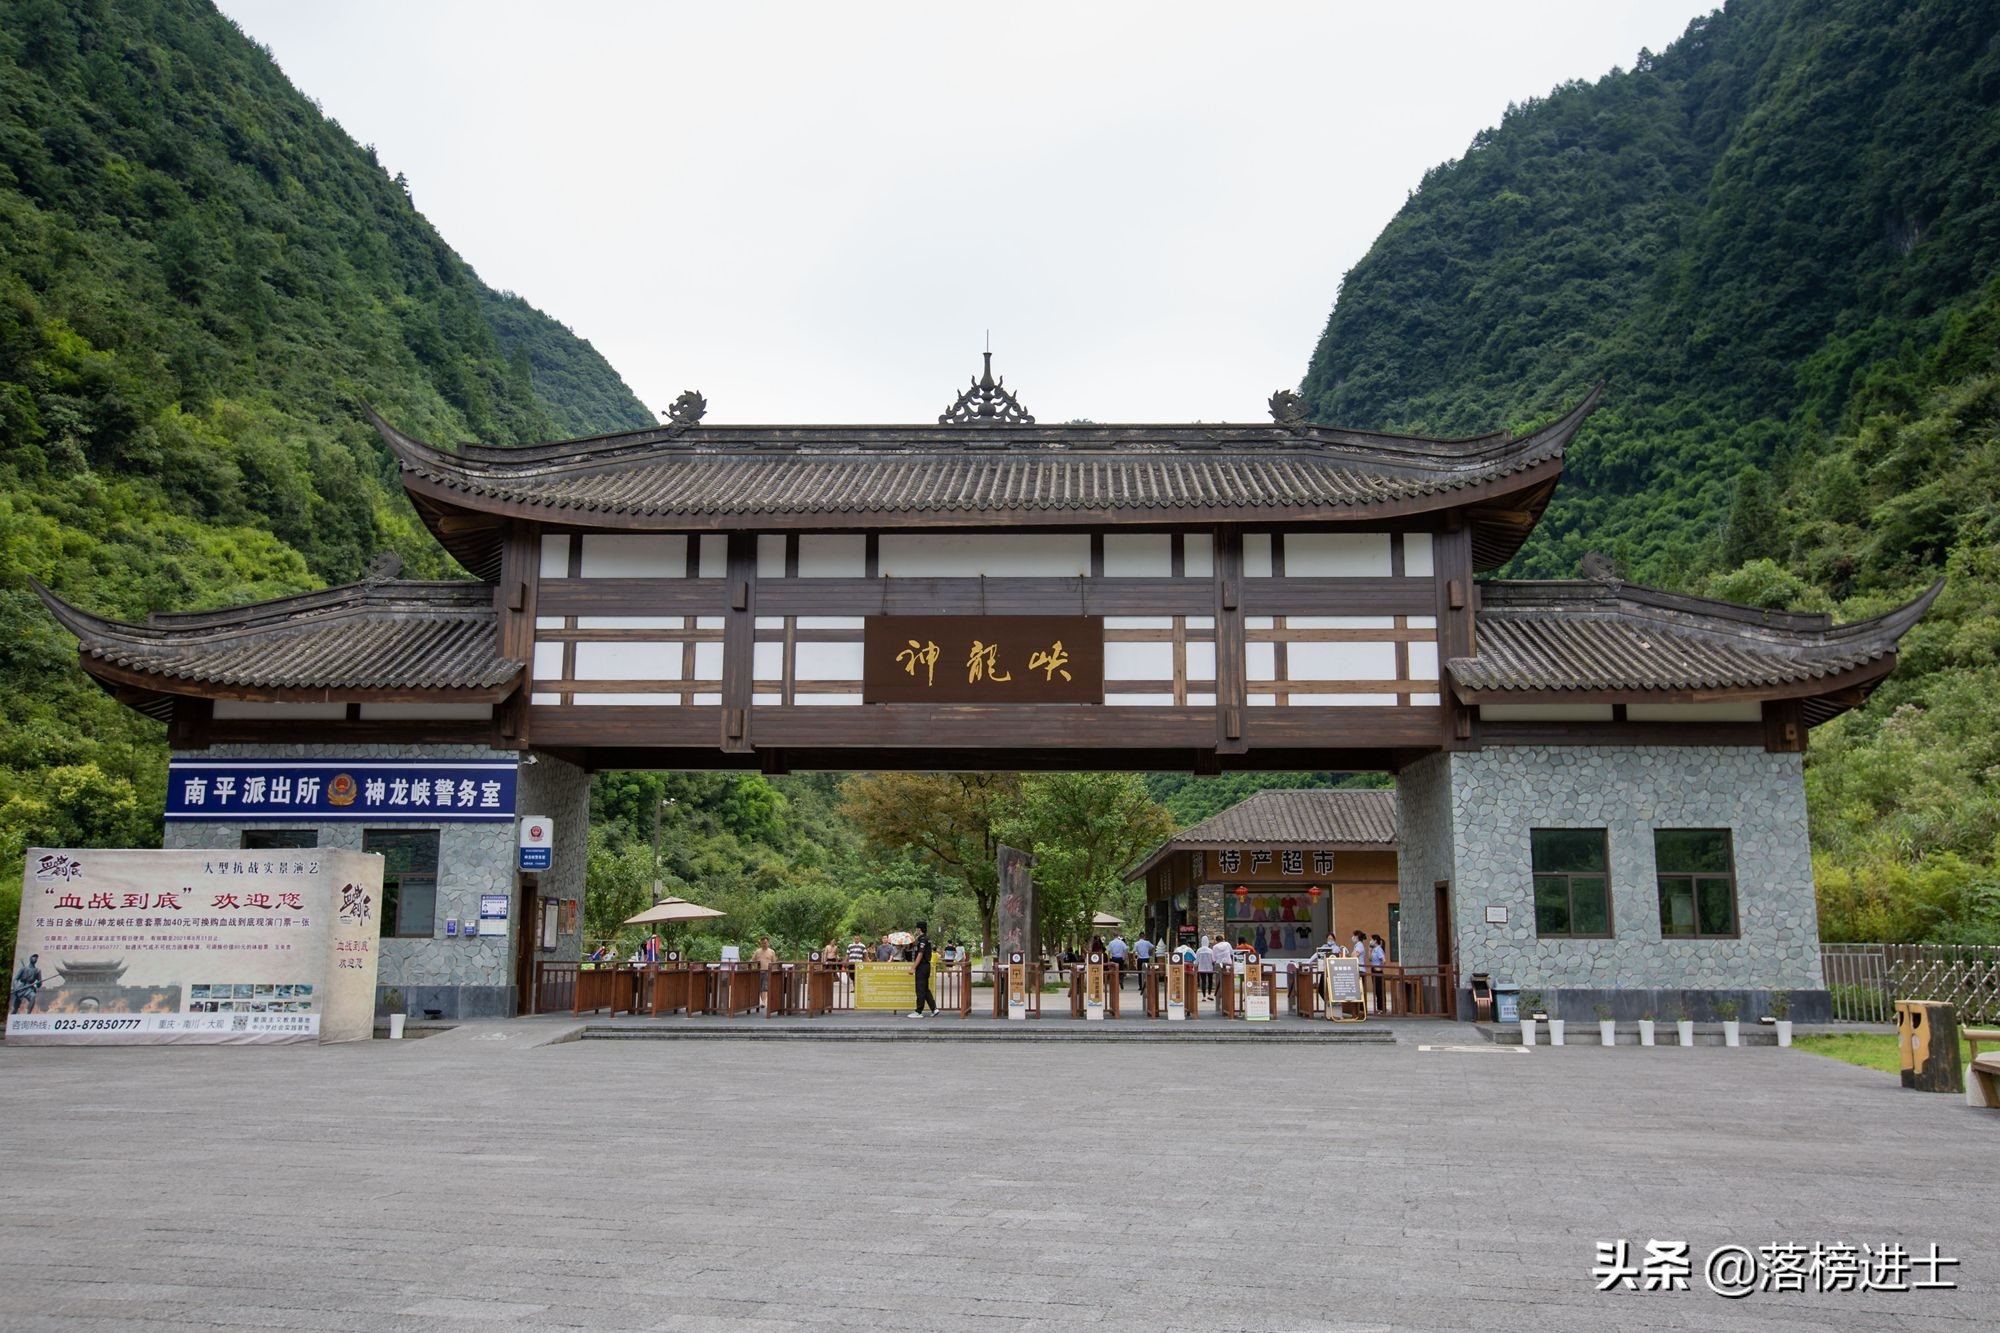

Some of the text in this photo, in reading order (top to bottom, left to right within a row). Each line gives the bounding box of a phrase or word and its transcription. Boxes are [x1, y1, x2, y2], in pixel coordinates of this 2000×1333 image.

[184, 776, 501, 808] 南平派出所 神龙峡警务室
[203, 861, 320, 875] 大型抗战实景演艺
[1218, 849, 1335, 875] 特产超市
[210, 892, 305, 911] 欢迎您
[54, 1019, 142, 1031] 023-87850777
